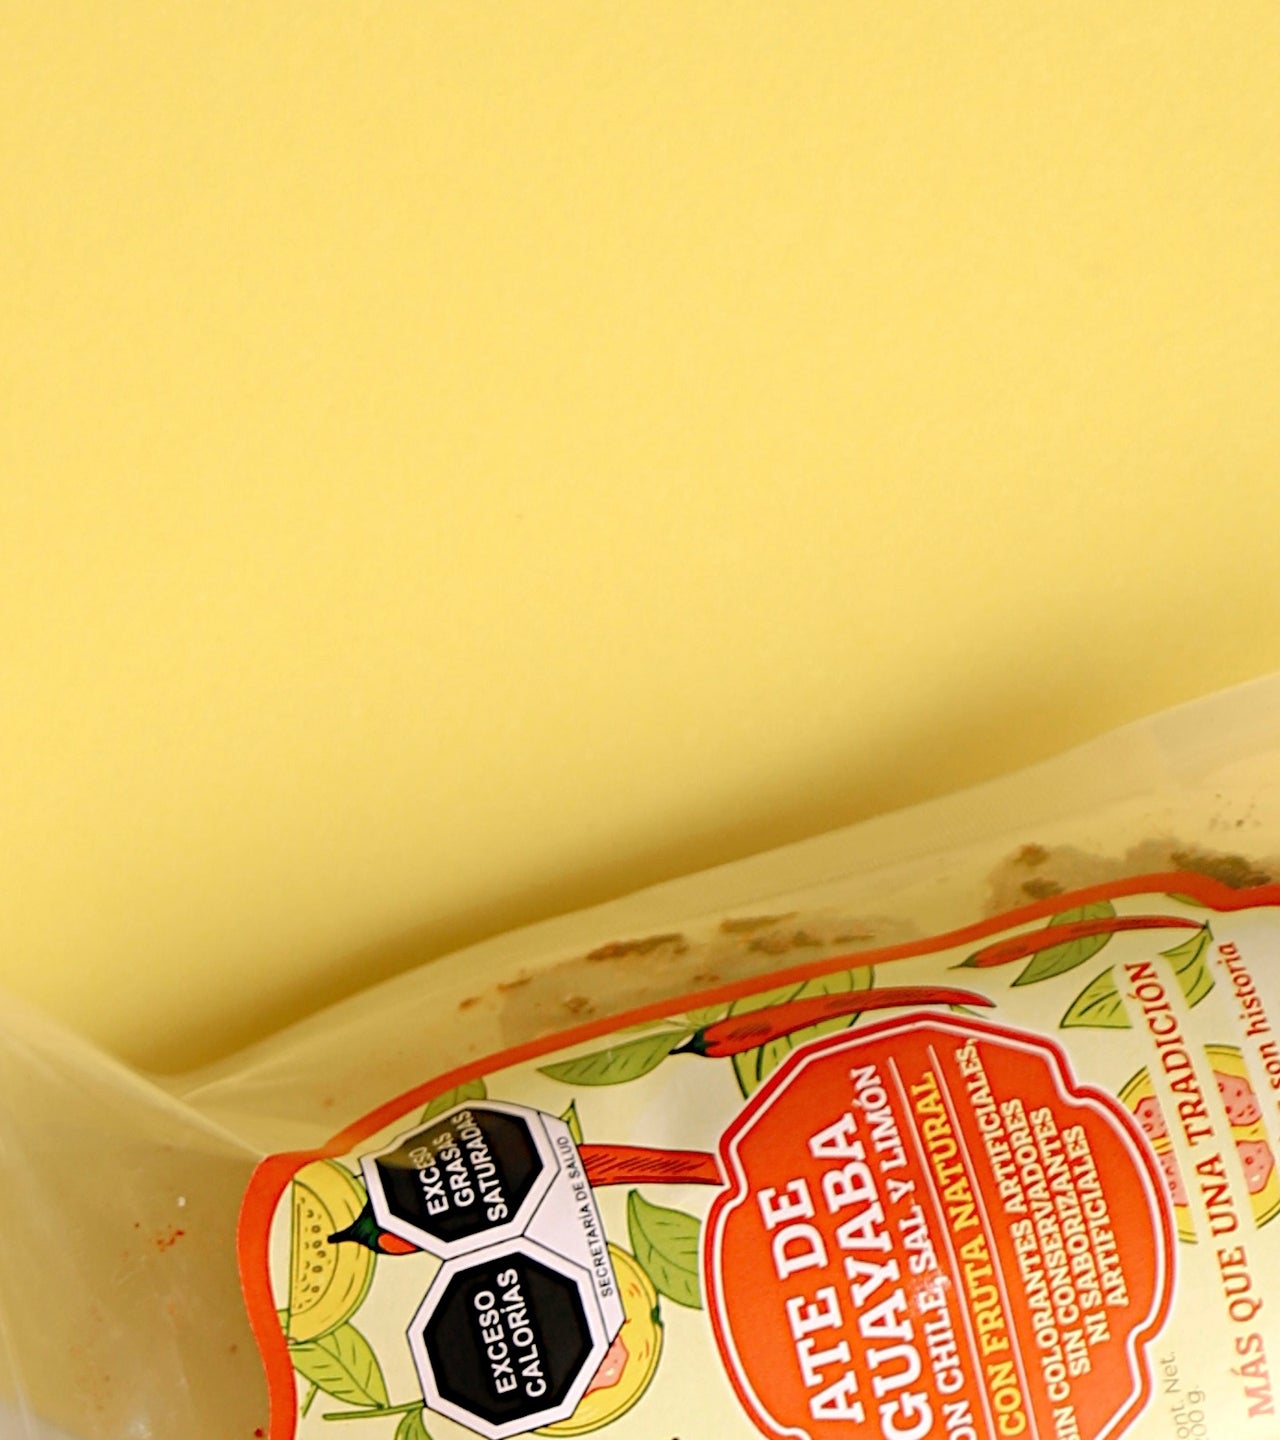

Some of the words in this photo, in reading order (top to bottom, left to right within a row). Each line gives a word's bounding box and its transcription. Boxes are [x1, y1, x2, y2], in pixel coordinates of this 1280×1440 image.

[1124, 960, 1215, 1145] TRADICIÓN
[851, 1065, 900, 1169] LIMÓN
[912, 1070, 980, 1234] NATURAL
[757, 1178, 829, 1279] DE
[898, 1176, 915, 1199] Y
[1003, 1098, 1078, 1334] CONSERVADORES
[1196, 1158, 1240, 1239] UNA
[498, 1267, 547, 1398] CALORÍAS
[952, 1248, 1006, 1354] FRUTA
[1008, 1223, 1071, 1399] COLORANTES
[1218, 1246, 1261, 1323] QUE
[474, 1288, 519, 1394] EXCESO
[785, 1287, 865, 1423] ATE
[1060, 1338, 1092, 1378] SIN
[982, 1359, 1026, 1436] CON
